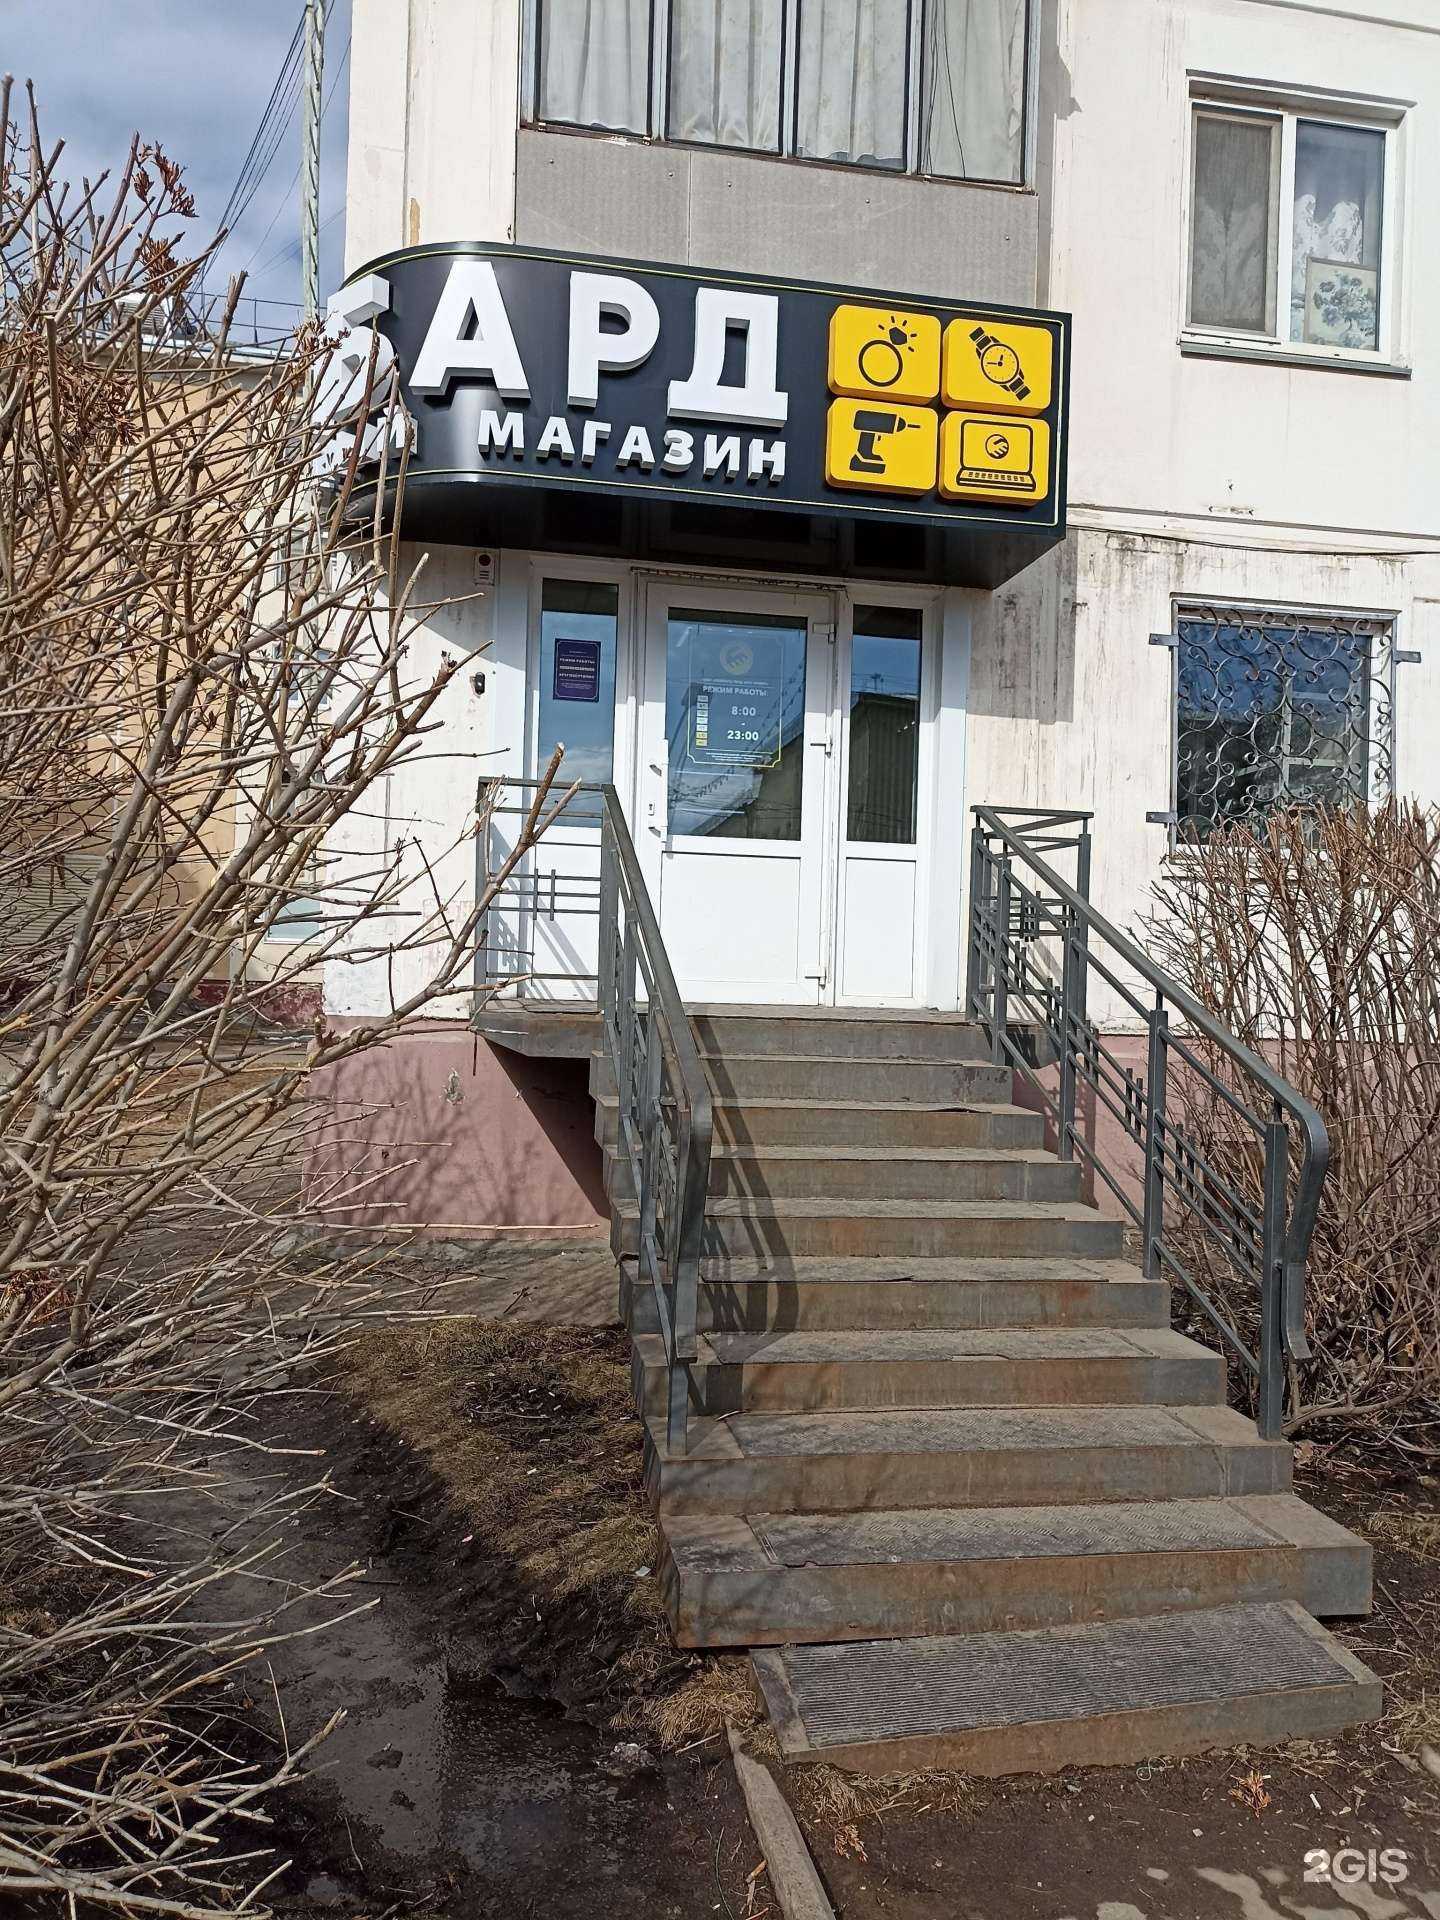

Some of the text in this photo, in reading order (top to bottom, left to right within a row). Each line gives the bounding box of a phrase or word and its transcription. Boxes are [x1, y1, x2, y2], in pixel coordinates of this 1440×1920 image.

[478, 409, 787, 481] МАГАЗИН
[731, 705, 757, 717] 8:00
[727, 729, 760, 741] 23:00
